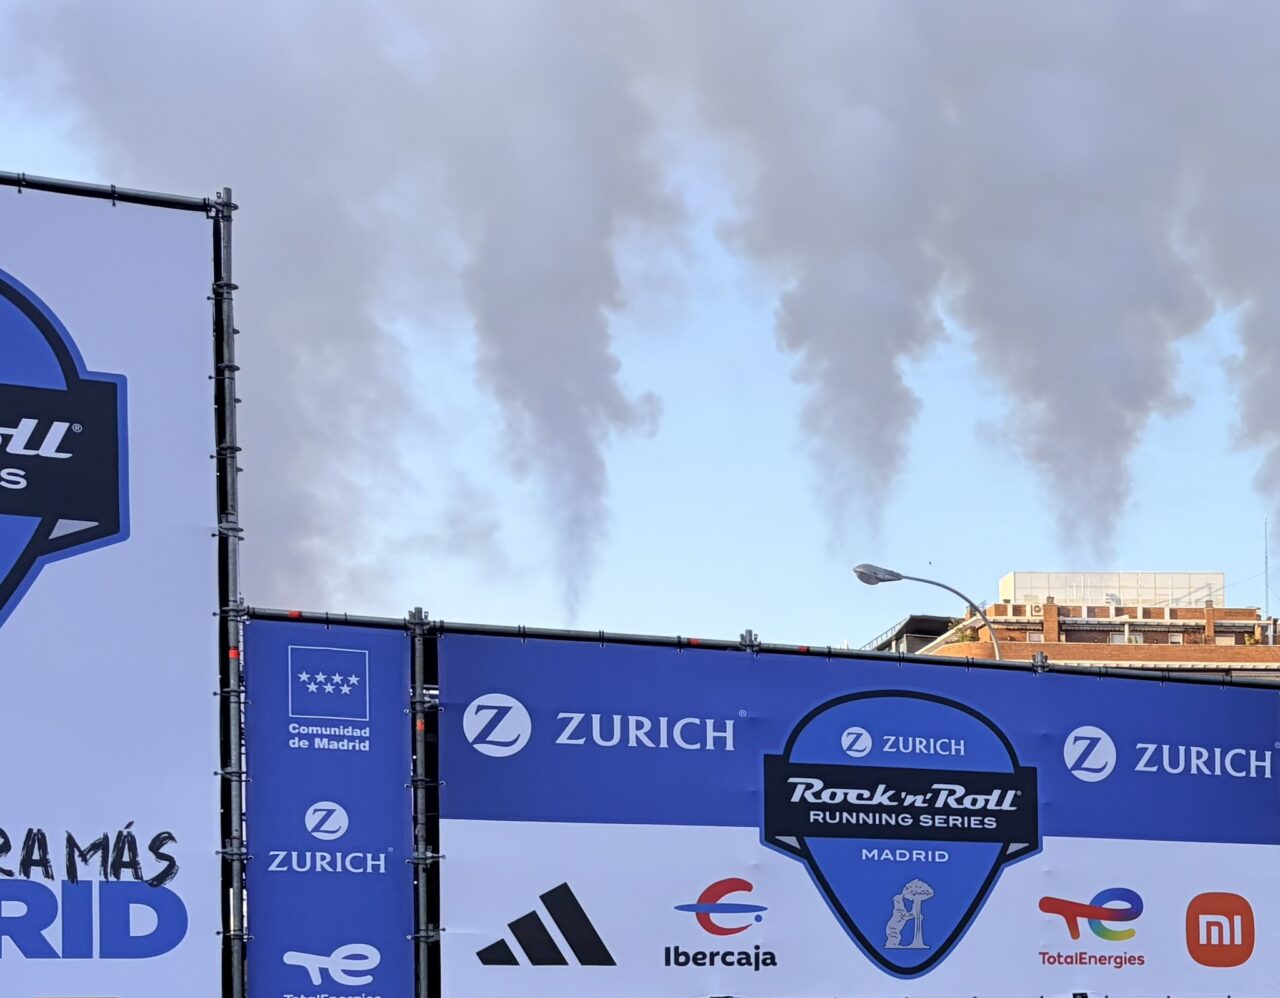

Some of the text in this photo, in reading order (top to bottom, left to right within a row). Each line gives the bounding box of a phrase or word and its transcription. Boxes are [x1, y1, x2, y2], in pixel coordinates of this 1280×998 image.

[289, 723, 370, 737] Comunidad
[555, 711, 736, 751] ZURICH
[289, 737, 370, 751] de Madrid
[882, 735, 965, 756] ZURICH
[1134, 742, 1272, 778] ZURICH
[787, 777, 899, 806] Rock
[931, 784, 1018, 811] Roll
[809, 810, 997, 829] RUNNING SERIES
[66, 821, 179, 887] MÁS
[267, 850, 387, 874] ZURICH
[862, 849, 949, 863] MADRID
[664, 945, 778, 972] Ibercaja
[1039, 951, 1145, 969] TotalEnergies
